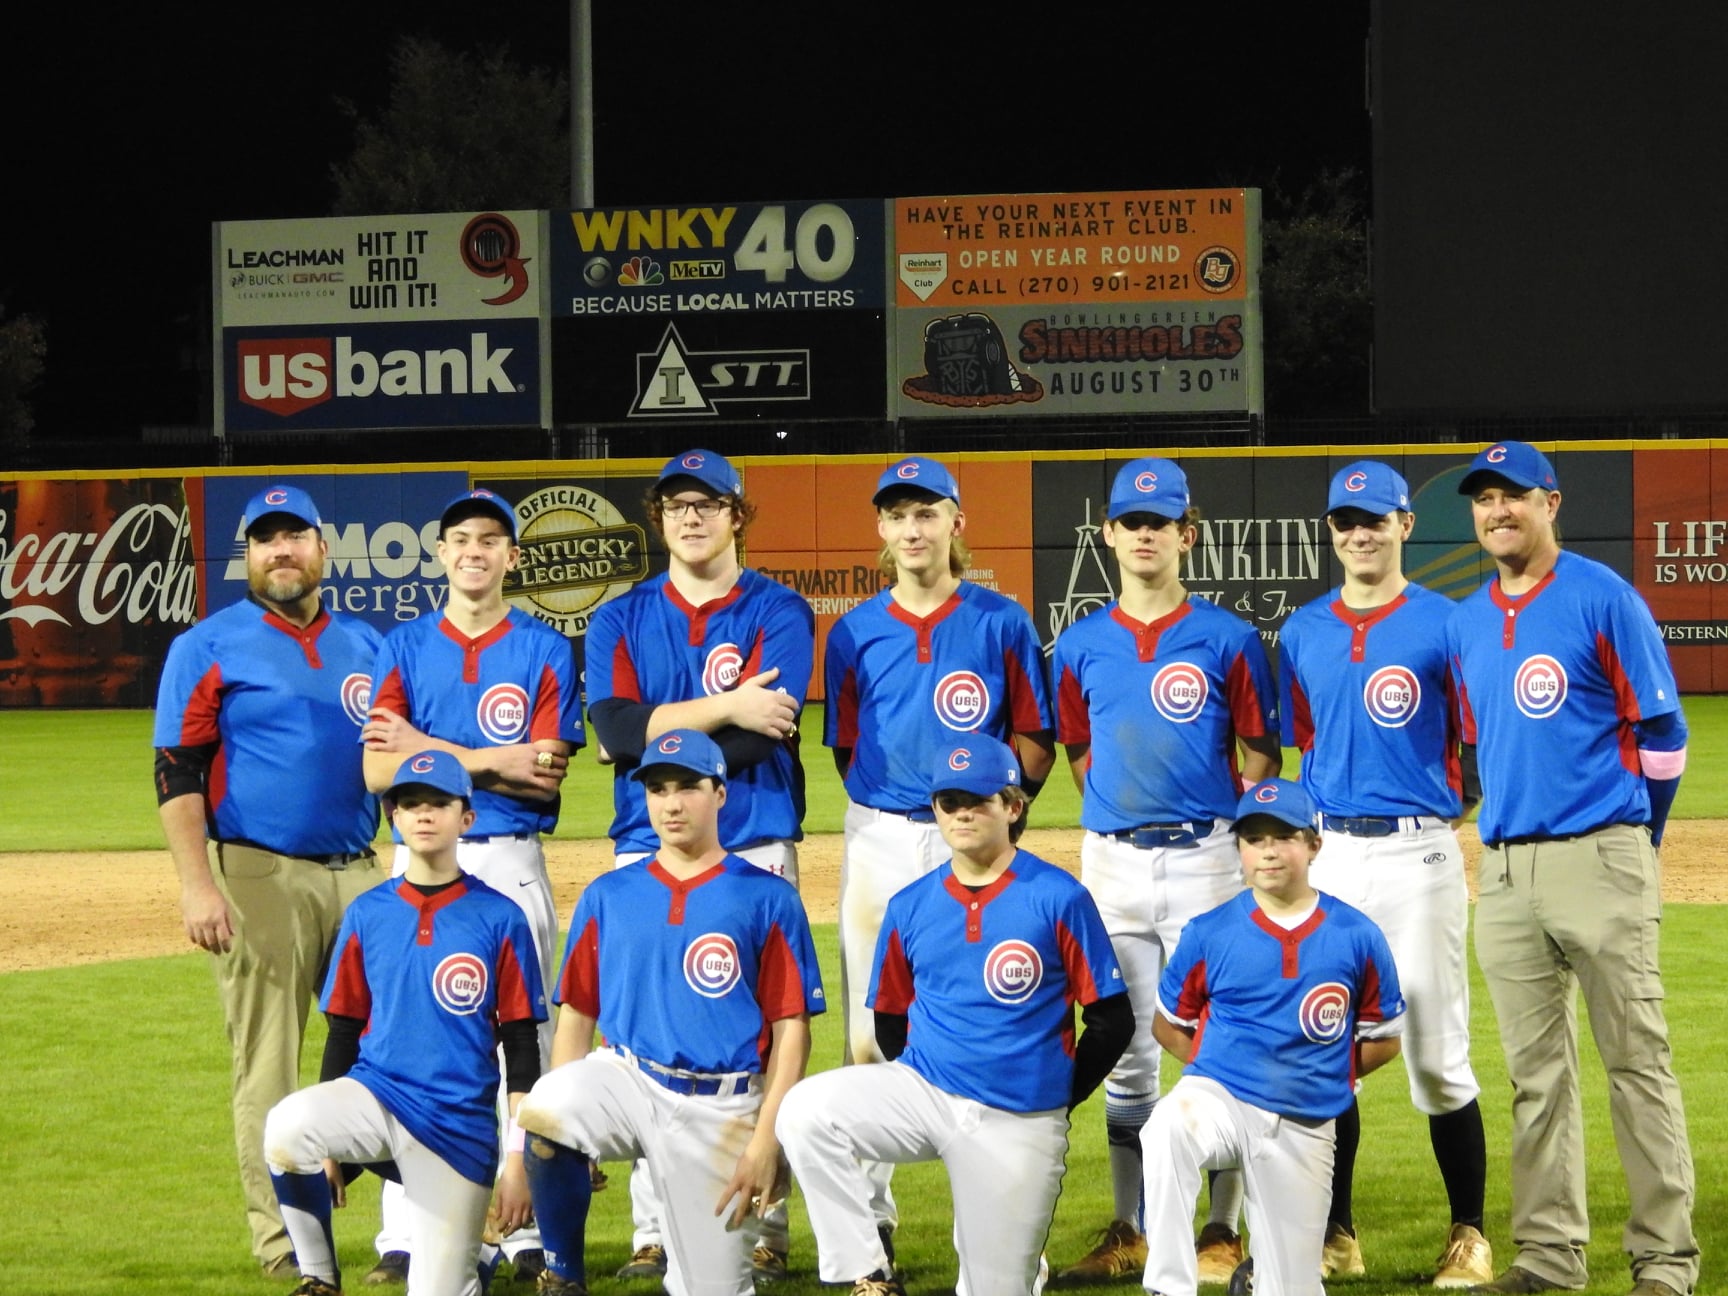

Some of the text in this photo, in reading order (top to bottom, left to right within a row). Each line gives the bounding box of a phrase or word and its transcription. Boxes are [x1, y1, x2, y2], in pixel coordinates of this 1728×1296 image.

[907, 198, 1232, 224] HAVE YOUR NEXT EVENT IN
[944, 218, 1197, 240] THE REINHART CLUB.
[358, 230, 428, 256] HIT IT
[571, 204, 855, 283] WNKY 40
[228, 248, 344, 268] LEACHMAN
[907, 259, 942, 267] Reinhart
[959, 249, 1017, 269] OPEN
[1031, 248, 1088, 267] YEAR
[1100, 245, 1181, 265] ROUND
[249, 272, 344, 286] BUICK GMC
[368, 257, 417, 282] AND
[914, 279, 933, 288] Club
[952, 278, 1007, 297] CALL
[1018, 276, 1079, 297] (270)
[1092, 274, 1190, 292] 901-2121
[350, 283, 436, 309] WIN IT!
[573, 289, 855, 314] BECAUSE LOCAL MATTERS
[1051, 312, 1215, 326] BOWLING GREEN
[702, 361, 803, 387] STT
[1051, 371, 1161, 395] AUGUST
[519, 490, 598, 521] OFFICIAL
[516, 538, 635, 570] ENTUCKY
[522, 559, 612, 586] LEGEND
[1655, 563, 1728, 583] IS WO
